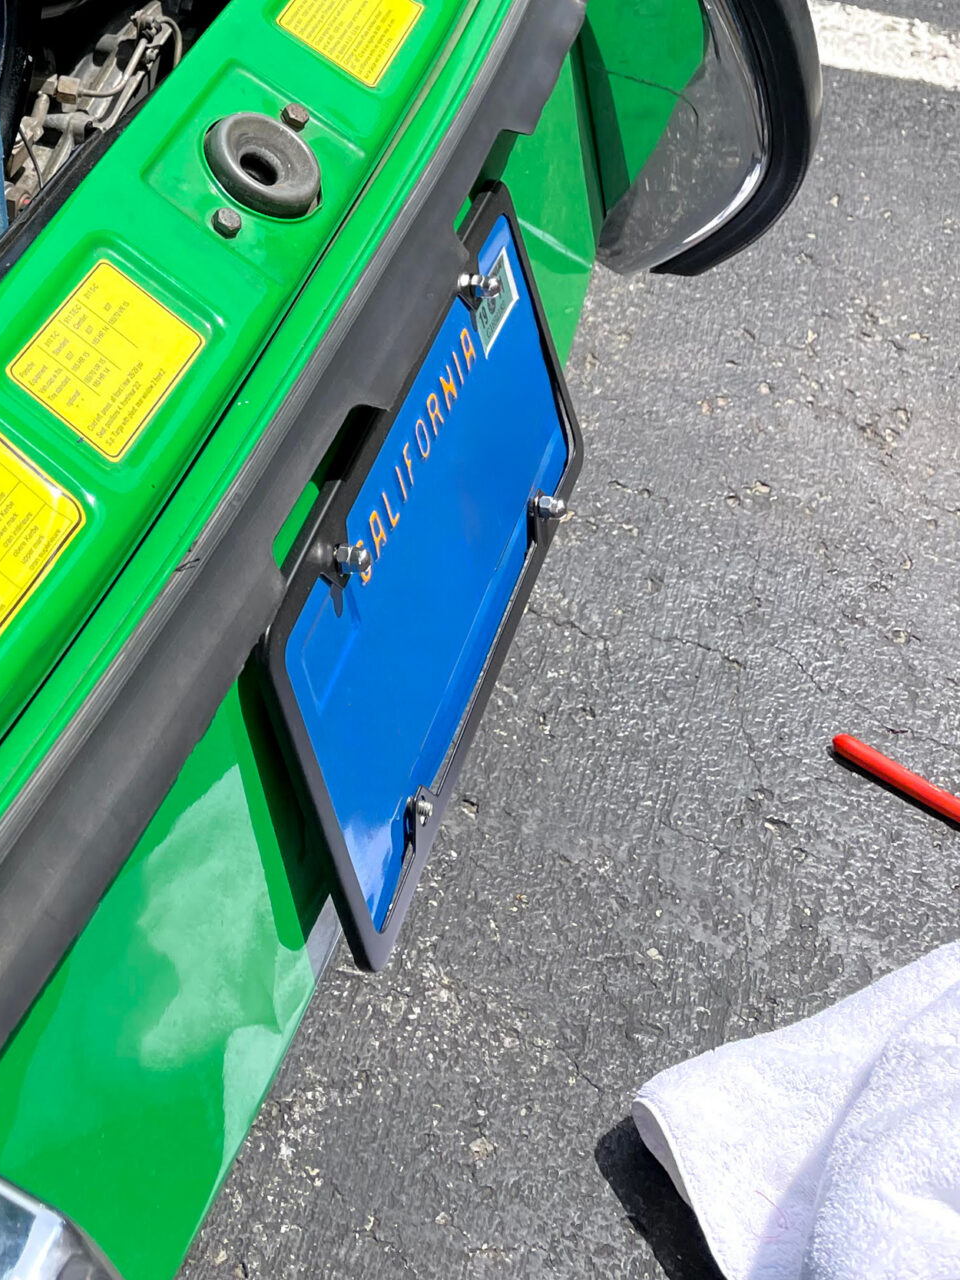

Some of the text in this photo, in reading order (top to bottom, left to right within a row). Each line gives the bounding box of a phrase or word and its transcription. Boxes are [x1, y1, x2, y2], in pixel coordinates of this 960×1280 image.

[0, 499, 15, 517] Kerbe
[4, 511, 19, 527] mark
[11, 523, 39, 557] obere Kerbe
[19, 533, 45, 565] upper mark
